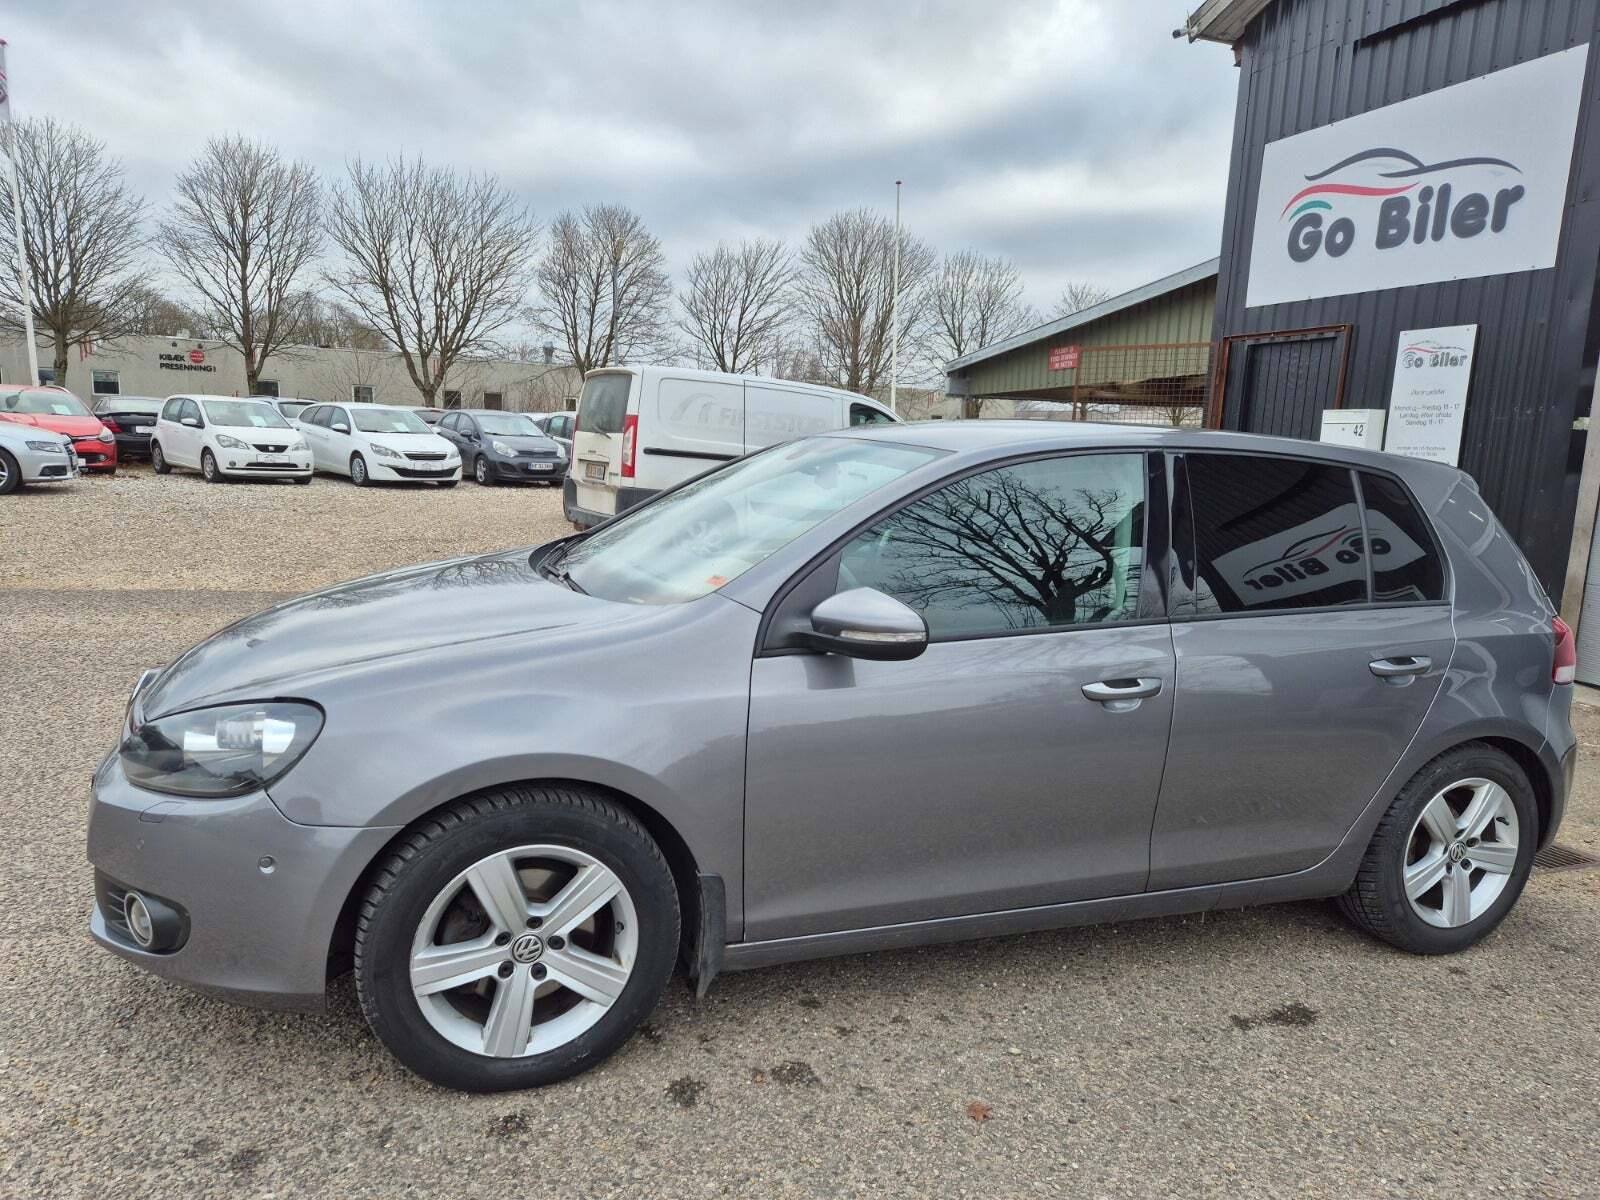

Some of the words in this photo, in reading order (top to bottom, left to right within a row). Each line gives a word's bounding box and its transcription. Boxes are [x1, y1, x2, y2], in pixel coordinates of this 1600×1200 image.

[1287, 212, 1356, 263] Go
[1375, 182, 1525, 250] Biler
[1402, 354, 1424, 369] Go
[1430, 351, 1467, 368] Biler
[1353, 424, 1364, 437] 42
